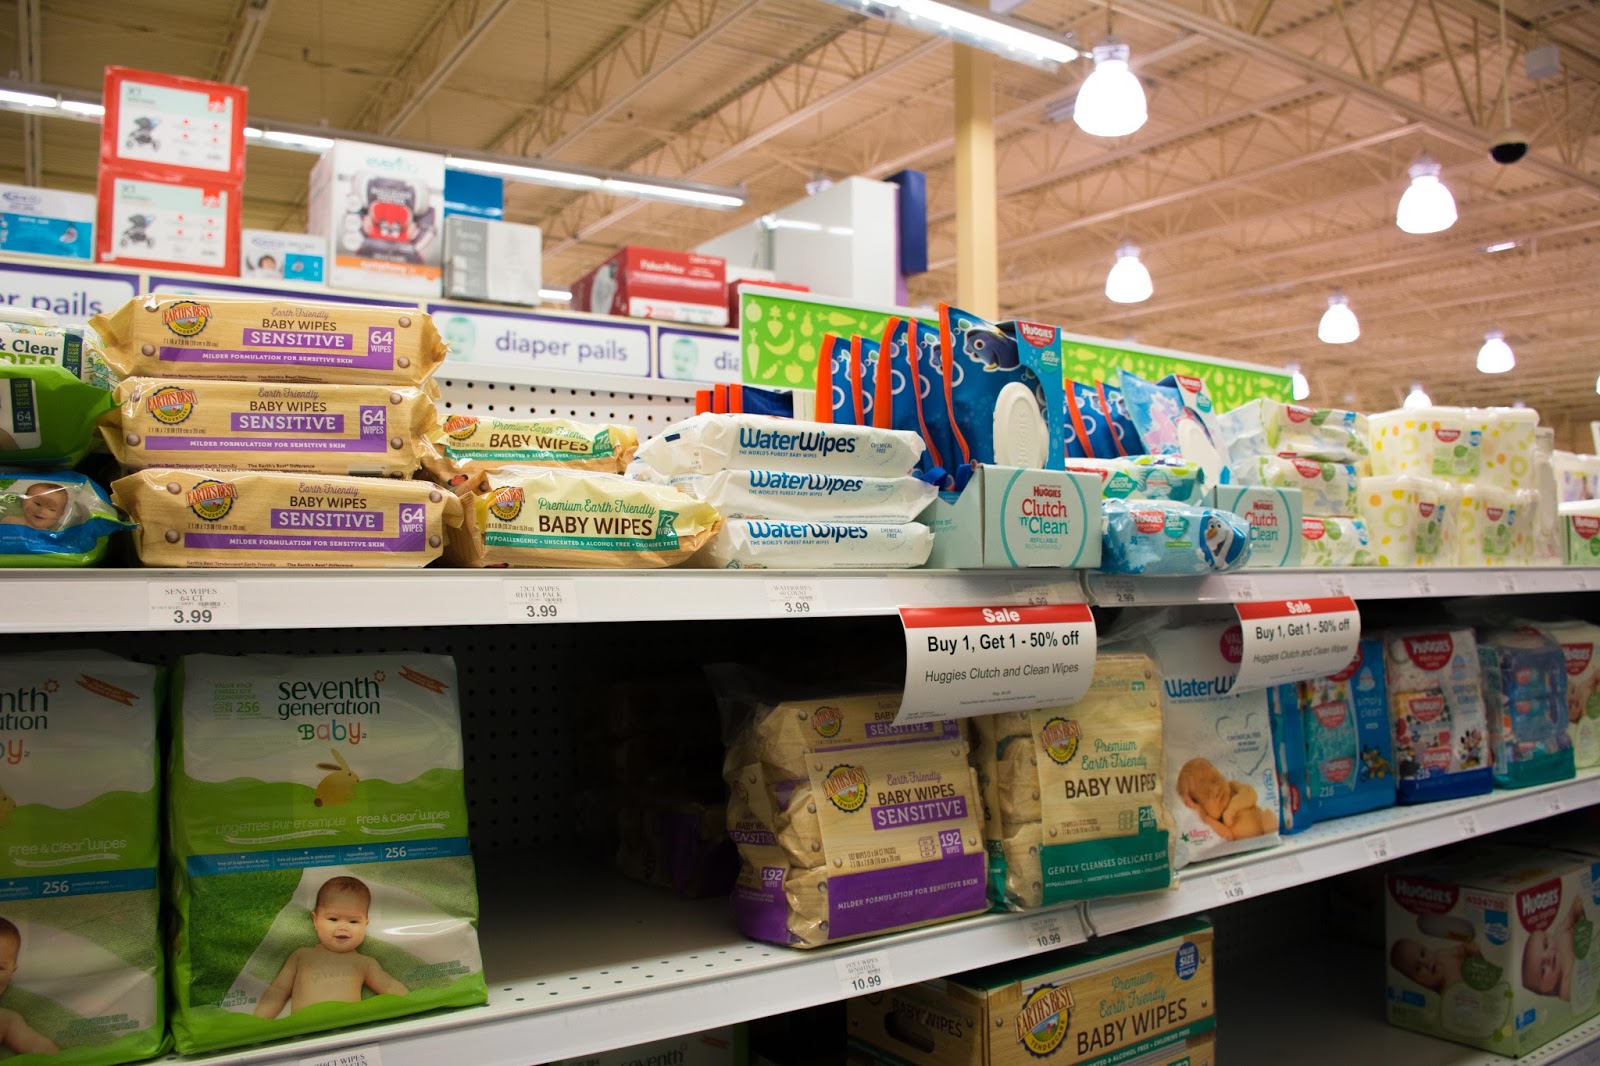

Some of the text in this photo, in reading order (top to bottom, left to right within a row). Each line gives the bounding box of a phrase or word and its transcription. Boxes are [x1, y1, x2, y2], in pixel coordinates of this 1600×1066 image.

[163, 306, 193, 324] EARTH'S
[271, 307, 330, 320] Earth Friendly
[262, 318, 337, 332] BABY WIPES
[1022, 323, 1053, 339] HUGGIES
[251, 331, 345, 348] SENSITIVE
[371, 330, 393, 345] 64
[495, 330, 628, 362] diaper pails
[12, 339, 59, 356] Clear
[371, 345, 392, 353] WIPES
[230, 353, 281, 361] FORMULATION
[258, 388, 319, 401] Earth Friendly
[250, 401, 327, 412] BABY WIPES
[239, 416, 336, 430] SENSITIVE
[362, 410, 385, 425] 64
[492, 420, 529, 431] Premium
[363, 426, 384, 434] WIPES
[490, 433, 589, 451] BABY WIPES
[739, 427, 856, 457] WaterWipes
[298, 482, 359, 498] Earth Friendly
[750, 470, 863, 495] WaterWipes
[186, 485, 214, 505] EARTH'S
[1033, 486, 1061, 498] HUGGIES
[290, 496, 367, 509] BABY WIPES
[538, 497, 656, 516] Premium Earth Friendly
[1022, 498, 1067, 518] Clutch
[279, 511, 375, 528] SENSITIVE
[401, 508, 424, 523] 64
[1245, 512, 1278, 527] Clutch
[402, 524, 423, 533] WIPES
[539, 515, 589, 533] BABY
[593, 517, 653, 536] WIPES
[747, 521, 868, 543] WaterWipes
[1029, 516, 1068, 534] Clean
[485, 536, 538, 544] HYPOALLERGENIC
[1250, 527, 1278, 541] Clean
[173, 609, 212, 623] 3.99
[526, 605, 557, 617] 3.99
[784, 602, 810, 613] 3.99
[982, 608, 1021, 623] Sale
[1286, 601, 1312, 614] Sale
[1256, 618, 1350, 642] Buy 1, Get 1 50% off
[927, 631, 1079, 655] Buy 1, Get 1 50% off
[1253, 644, 1348, 665] Huggies Clutch and Clean Wipes
[925, 663, 1079, 684] Huggies Clutch and Clean Wipes
[278, 677, 380, 700] seventh
[236, 701, 260, 713] 256
[278, 699, 380, 720] generation
[297, 719, 361, 745] Baby
[1095, 738, 1137, 754] Premium
[1081, 755, 1110, 770] Earth
[821, 770, 851, 798] EARTH'S
[887, 769, 942, 785] Earth Friendly
[877, 783, 956, 806] BABY WIPES
[1065, 777, 1110, 799] BABY
[356, 809, 450, 826] Free & Clear Wipes
[877, 800, 962, 826] SENSITIVE
[940, 832, 961, 848] 192
[385, 846, 406, 858] 256
[1047, 852, 1153, 876] GENTLY CLEANSES DELICATE
[762, 869, 783, 881] 192
[42, 880, 70, 895] 256
[838, 878, 978, 910] MILDER FORMULATION FOR SENSITIVE SKIN
[1224, 887, 1244, 899] 14.99
[1395, 879, 1452, 904] HUGGIES
[1522, 887, 1559, 916] HUGGIES
[1036, 933, 1061, 947] 10.99
[1179, 953, 1195, 967] SIZE
[851, 974, 881, 991] 10.99
[1112, 971, 1155, 992] Premium
[1100, 986, 1166, 1018] Earth Friendly
[1015, 985, 1074, 1038] EARTH'S BEST
[1077, 998, 1187, 1056] BABY WIPES
[1030, 1019, 1066, 1054] TENDERCARE
[1112, 1042, 1150, 1061] ALCOHOL FREE
